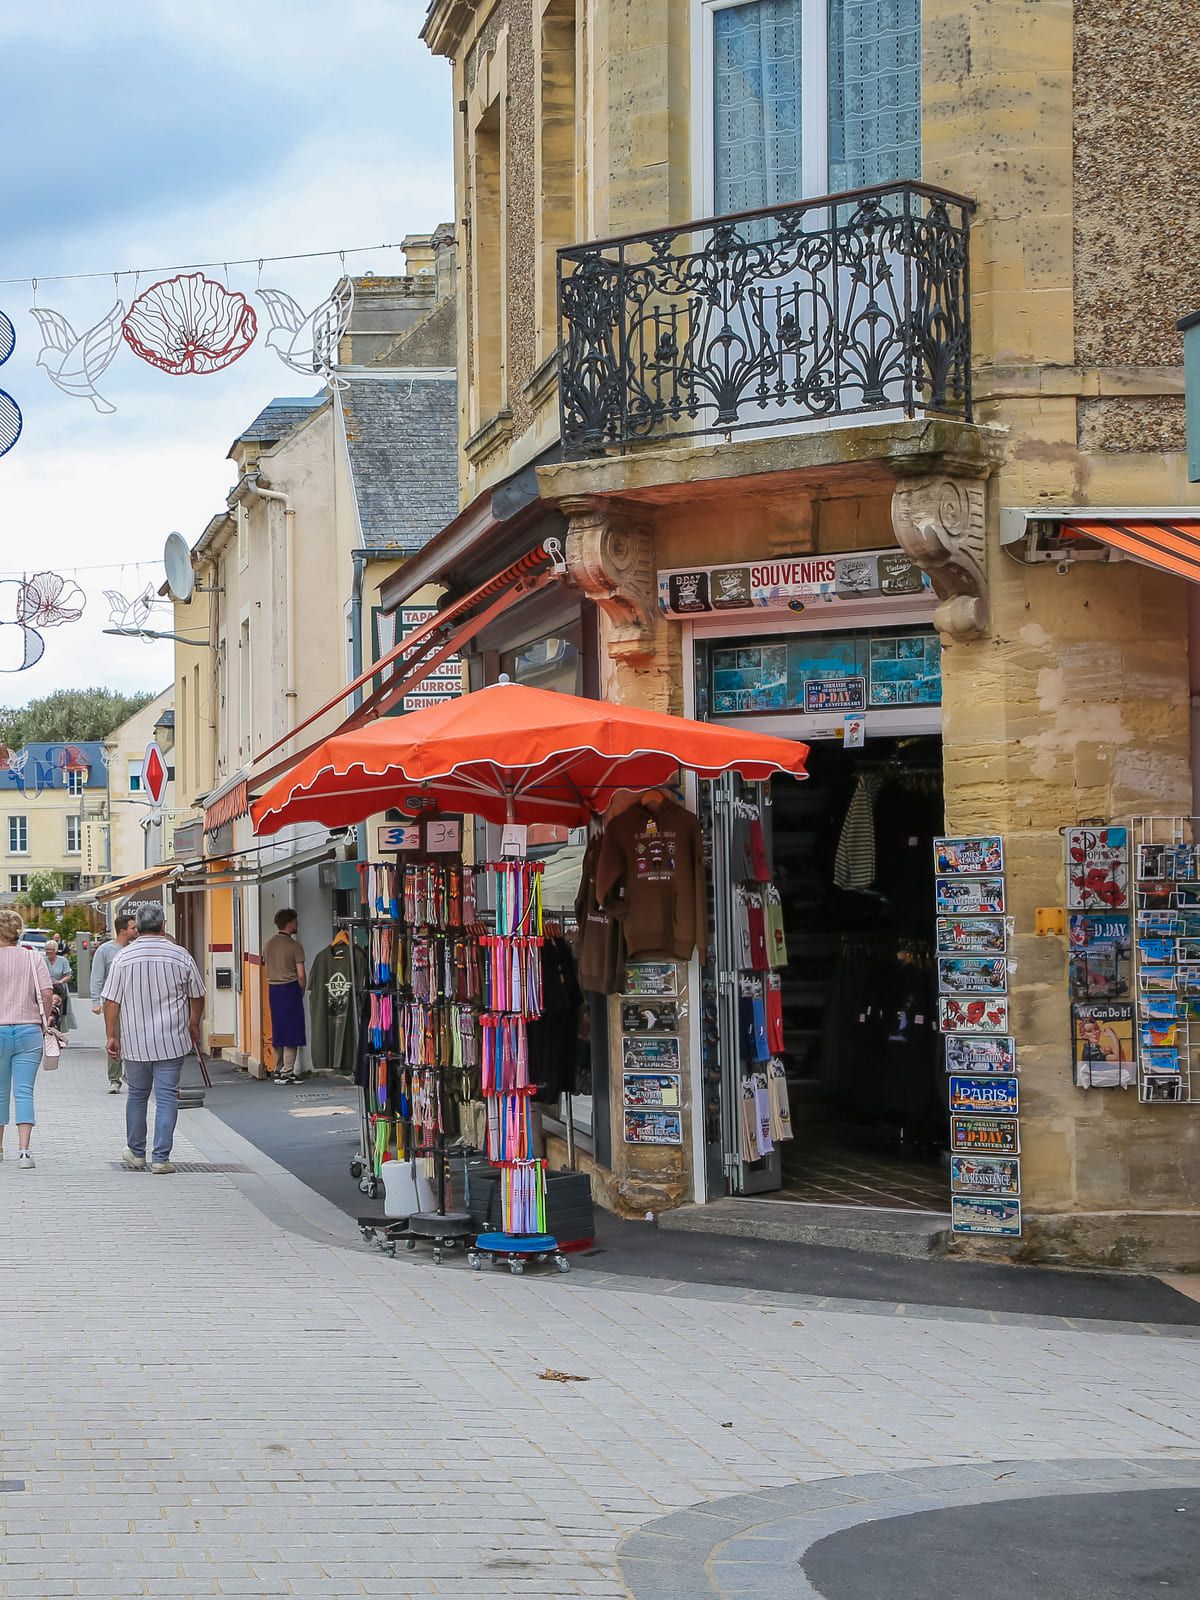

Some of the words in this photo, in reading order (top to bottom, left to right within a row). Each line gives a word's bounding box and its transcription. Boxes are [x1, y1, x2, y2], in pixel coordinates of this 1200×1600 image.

[404, 612, 440, 622] TAPA
[412, 682, 461, 692] HURROS
[819, 691, 851, 703] D-DAY
[1094, 923, 1127, 937] D.DAY
[1092, 1008, 1107, 1018] Can
[1108, 1007, 1120, 1017] Do
[1121, 1006, 1131, 1017] It!
[959, 1087, 1008, 1102] PARIS
[967, 1131, 1003, 1143] D-DAY
